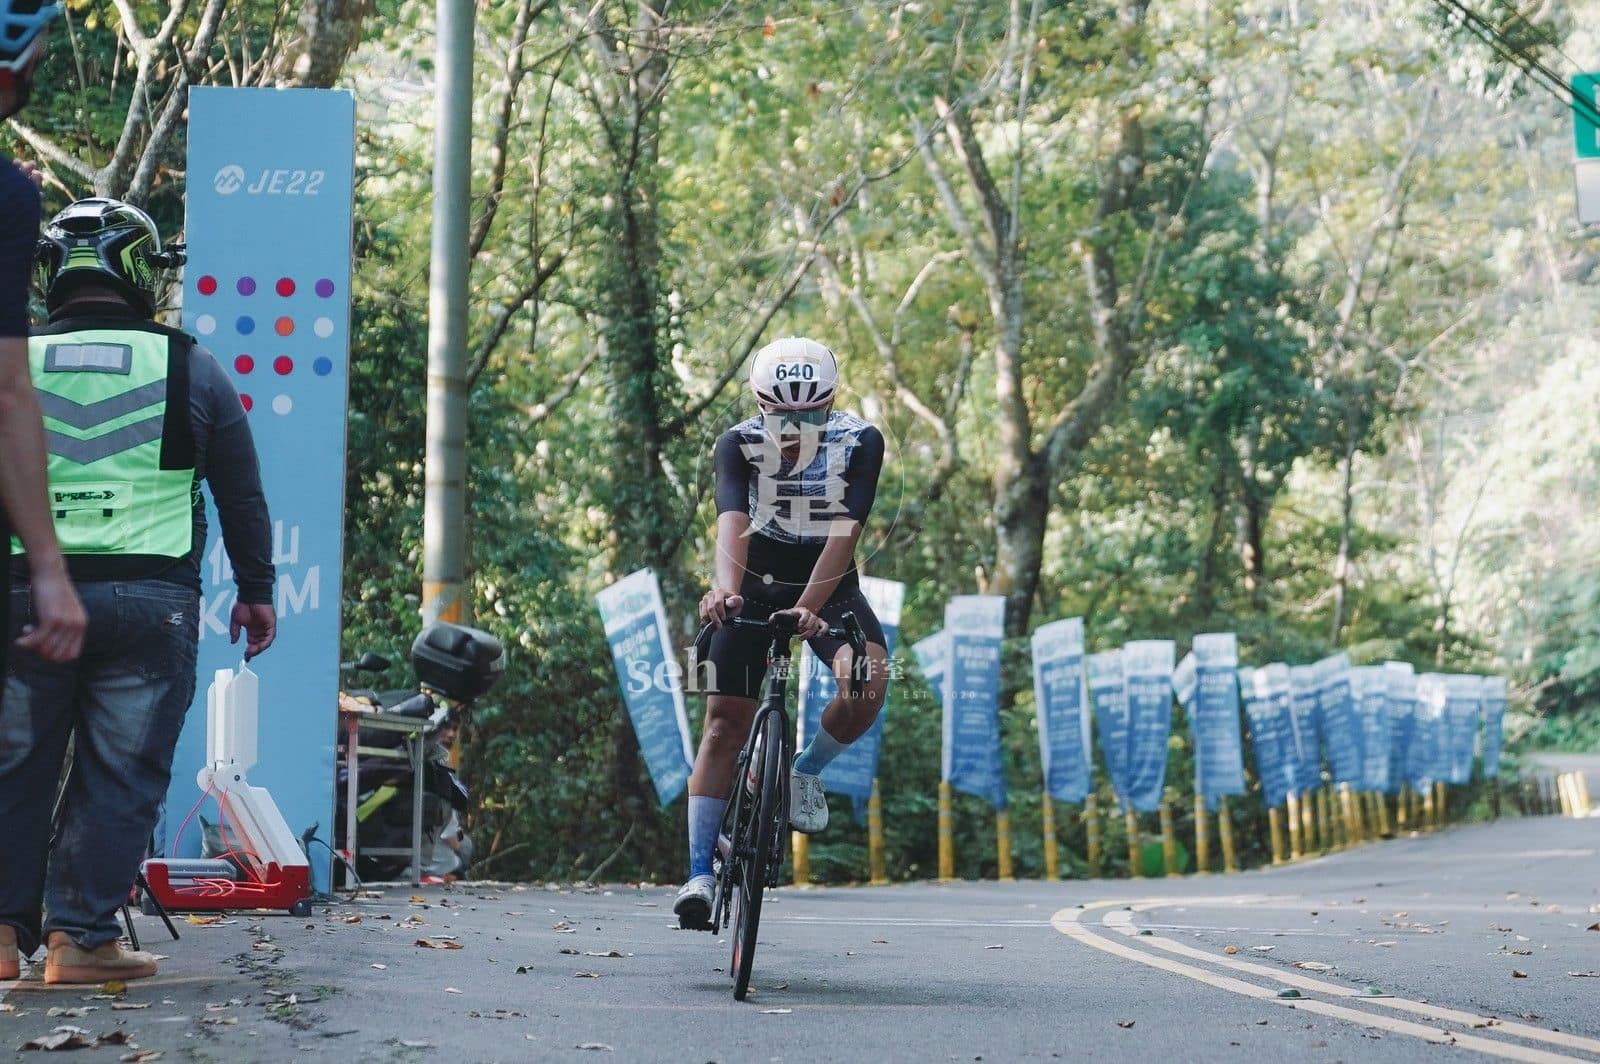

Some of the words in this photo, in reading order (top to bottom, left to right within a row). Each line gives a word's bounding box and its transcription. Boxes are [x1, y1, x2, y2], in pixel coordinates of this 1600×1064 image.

[247, 170, 324, 195] JE22
[775, 363, 814, 381] 640
[198, 565, 320, 641] KM
